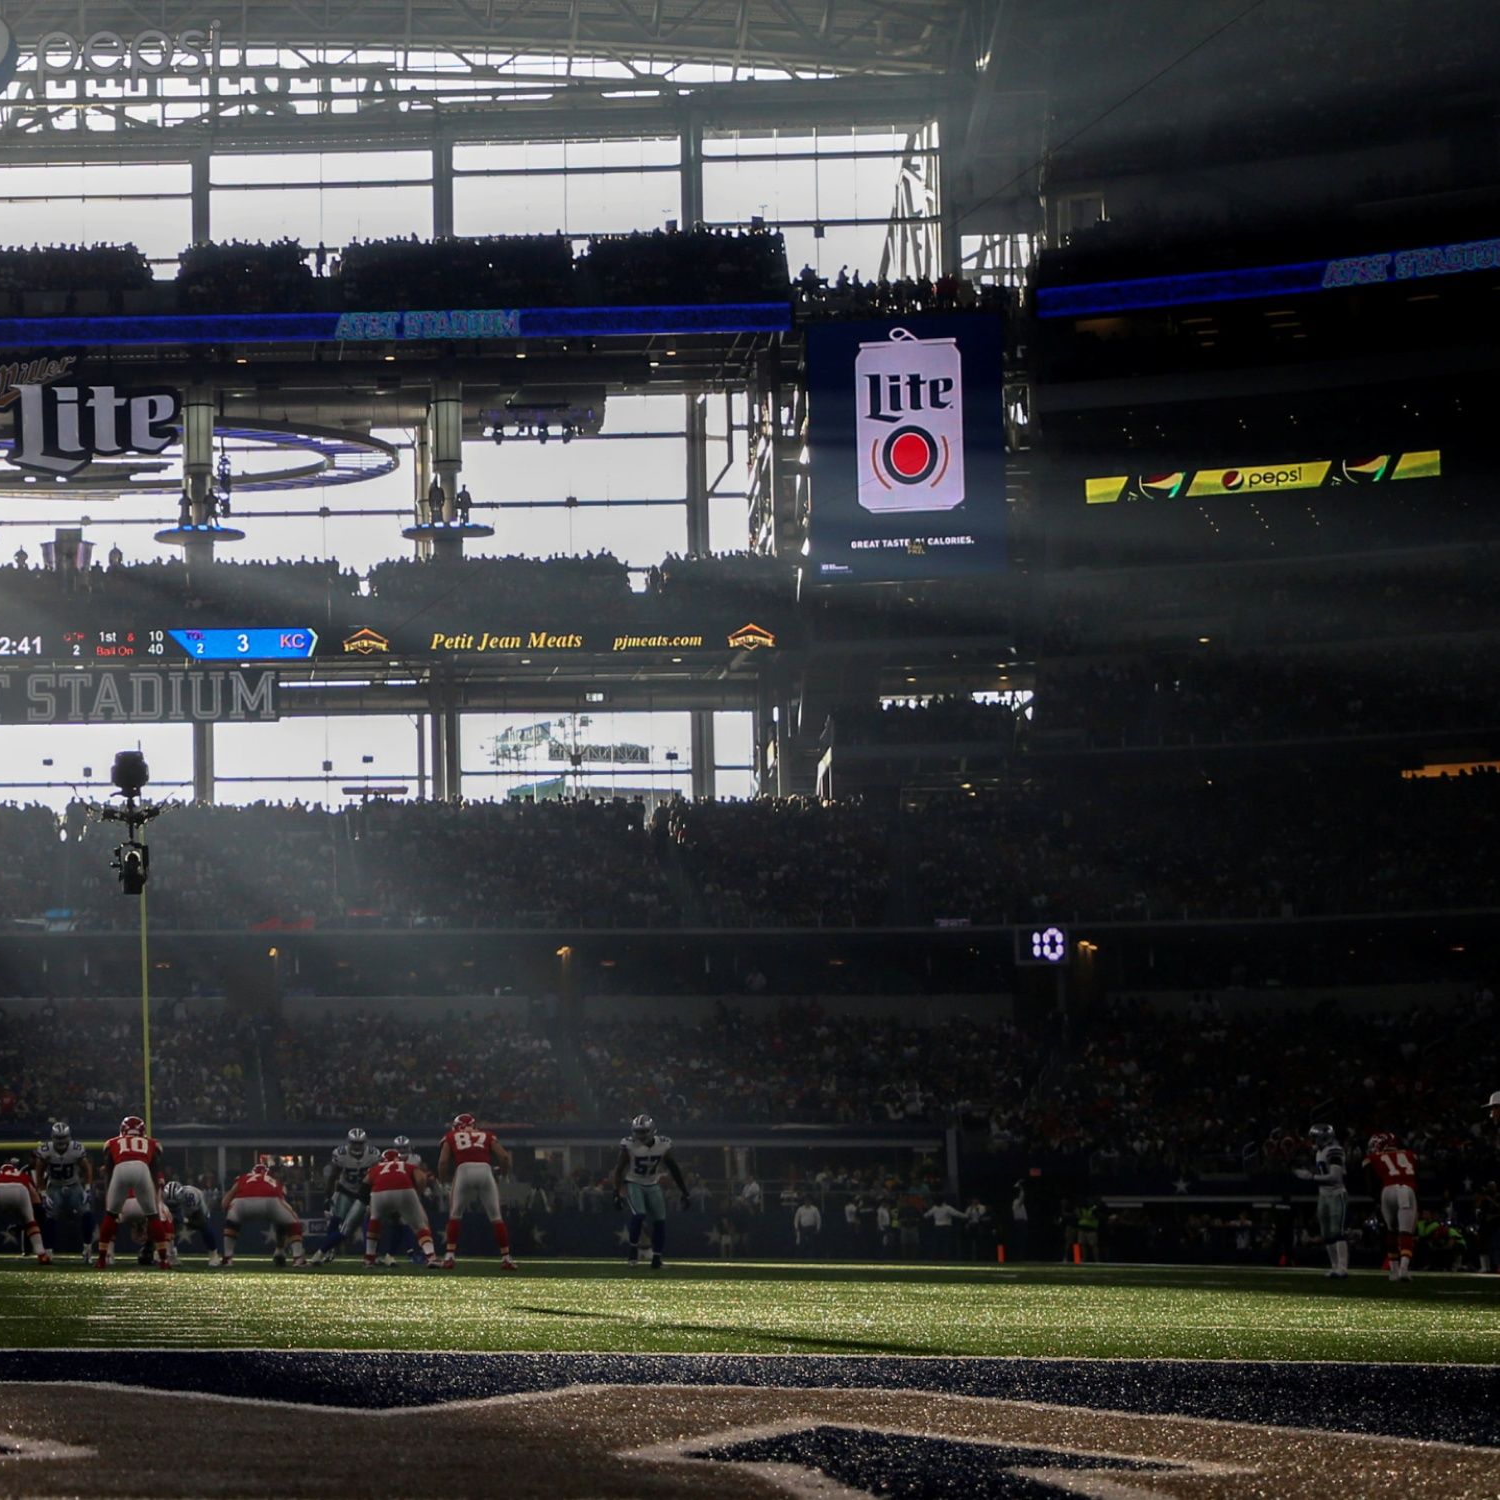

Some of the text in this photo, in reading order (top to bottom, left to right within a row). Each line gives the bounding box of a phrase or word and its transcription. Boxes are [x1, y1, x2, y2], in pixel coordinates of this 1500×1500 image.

[37, 19, 220, 95] pepsi
[1322, 239, 1500, 288] AT&T STADIU
[335, 309, 520, 340] AT&T STADIUM
[863, 373, 954, 423] Lite
[10, 384, 175, 472] Lite
[1249, 467, 1302, 487] pepsi
[851, 540, 880, 549] GREAT
[927, 535, 975, 545] CALORIES.
[100, 631, 116, 642] 1st
[149, 630, 163, 642] 10
[237, 633, 305, 652] 3 KC
[431, 631, 582, 651] Petit Jean Meats
[613, 635, 702, 650] pjmeats.com
[72, 644, 80, 656] 2
[96, 643, 163, 656] Ball On 40
[196, 643, 204, 654] 2
[27, 671, 276, 721] STADIUM
[1032, 927, 1064, 961] 10
[117, 1137, 149, 1155] 10
[454, 1131, 487, 1150] 87
[379, 1160, 407, 1175] 71
[635, 1155, 661, 1175] 57
[1380, 1153, 1415, 1176] 14
